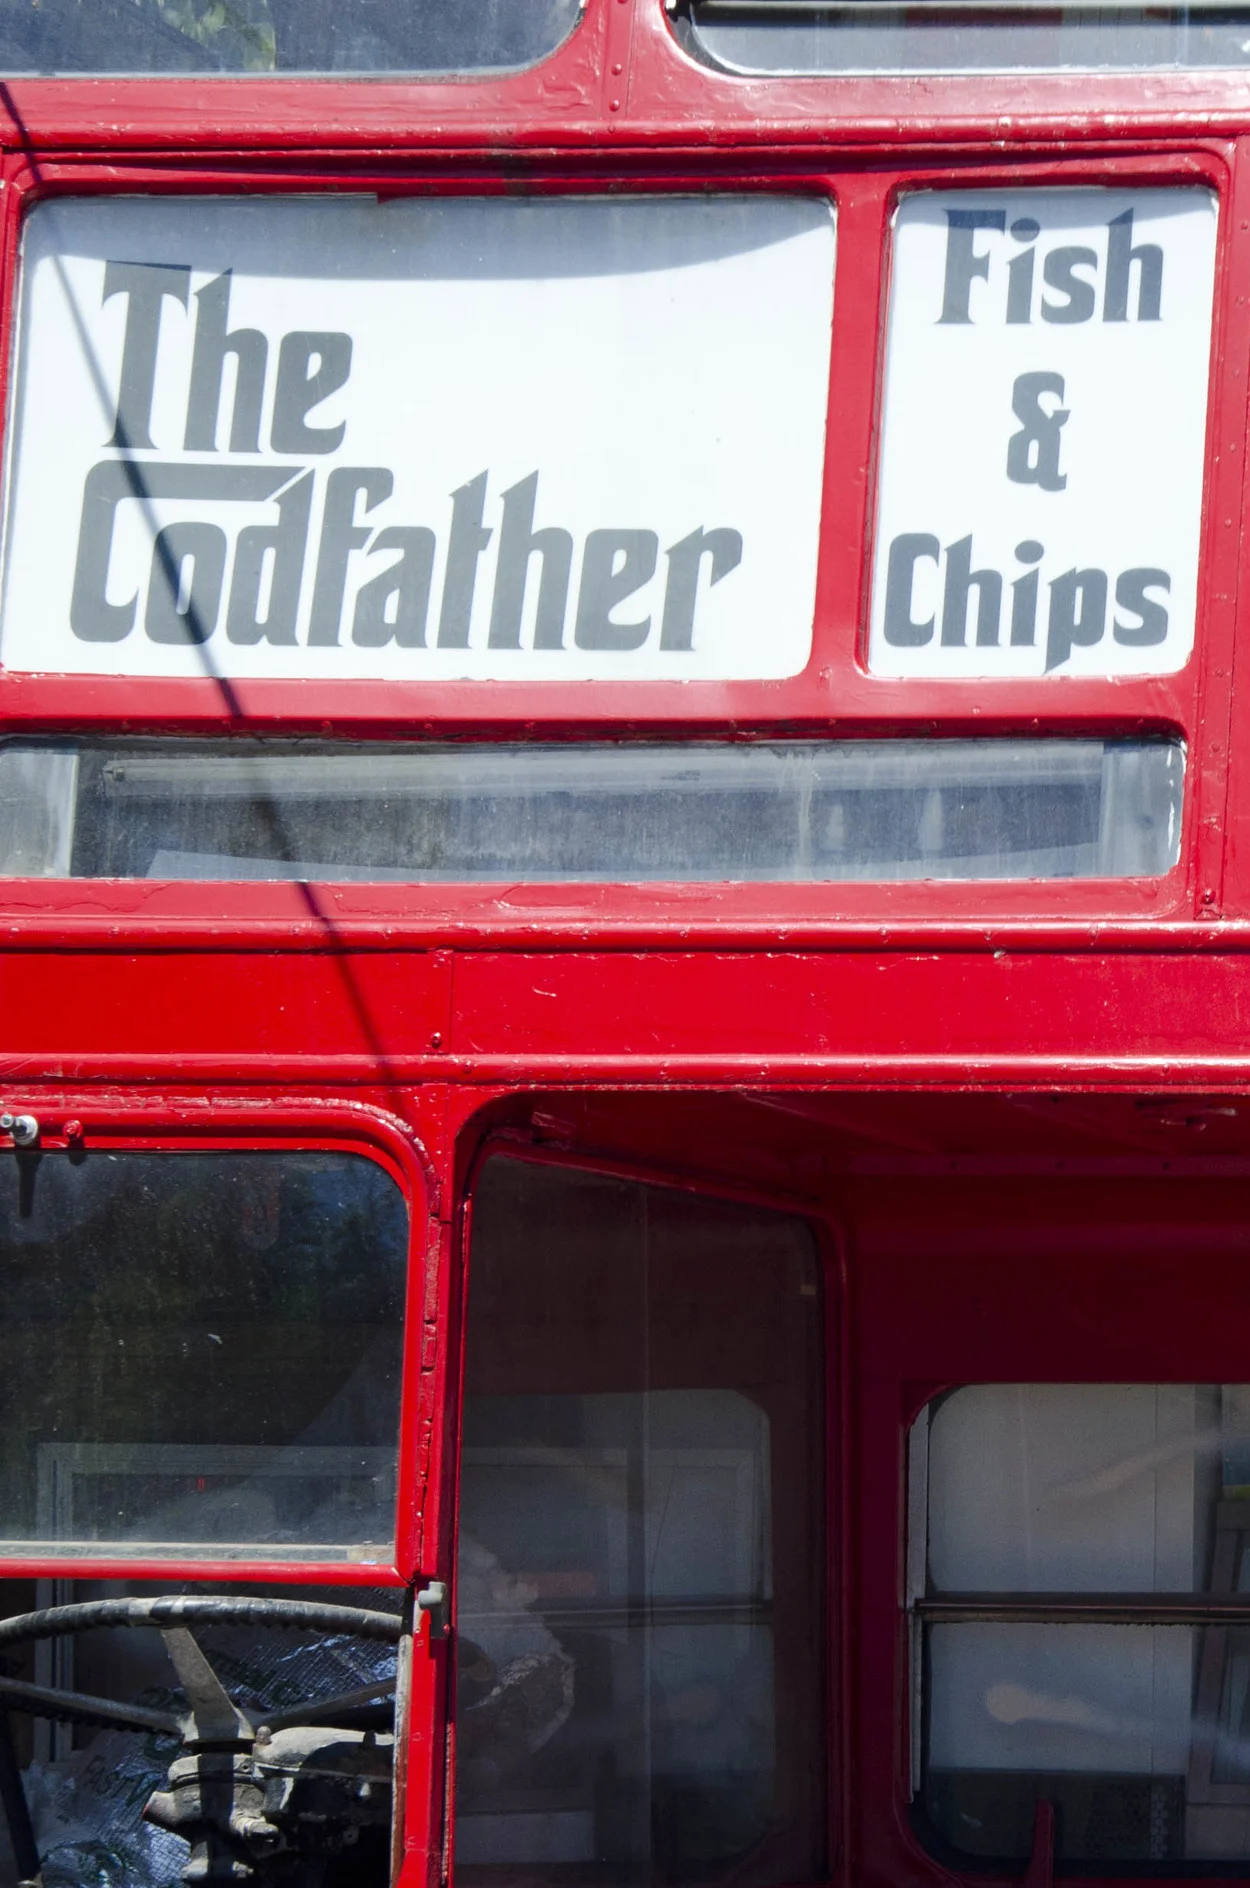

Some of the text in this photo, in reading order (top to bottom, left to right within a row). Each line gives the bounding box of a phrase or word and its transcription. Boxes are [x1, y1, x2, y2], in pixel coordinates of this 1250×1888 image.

[933, 207, 1164, 325] Fish
[101, 259, 353, 455] The
[1006, 371, 1071, 492] &
[70, 459, 743, 652] Codfather
[883, 532, 1171, 674] Chips
